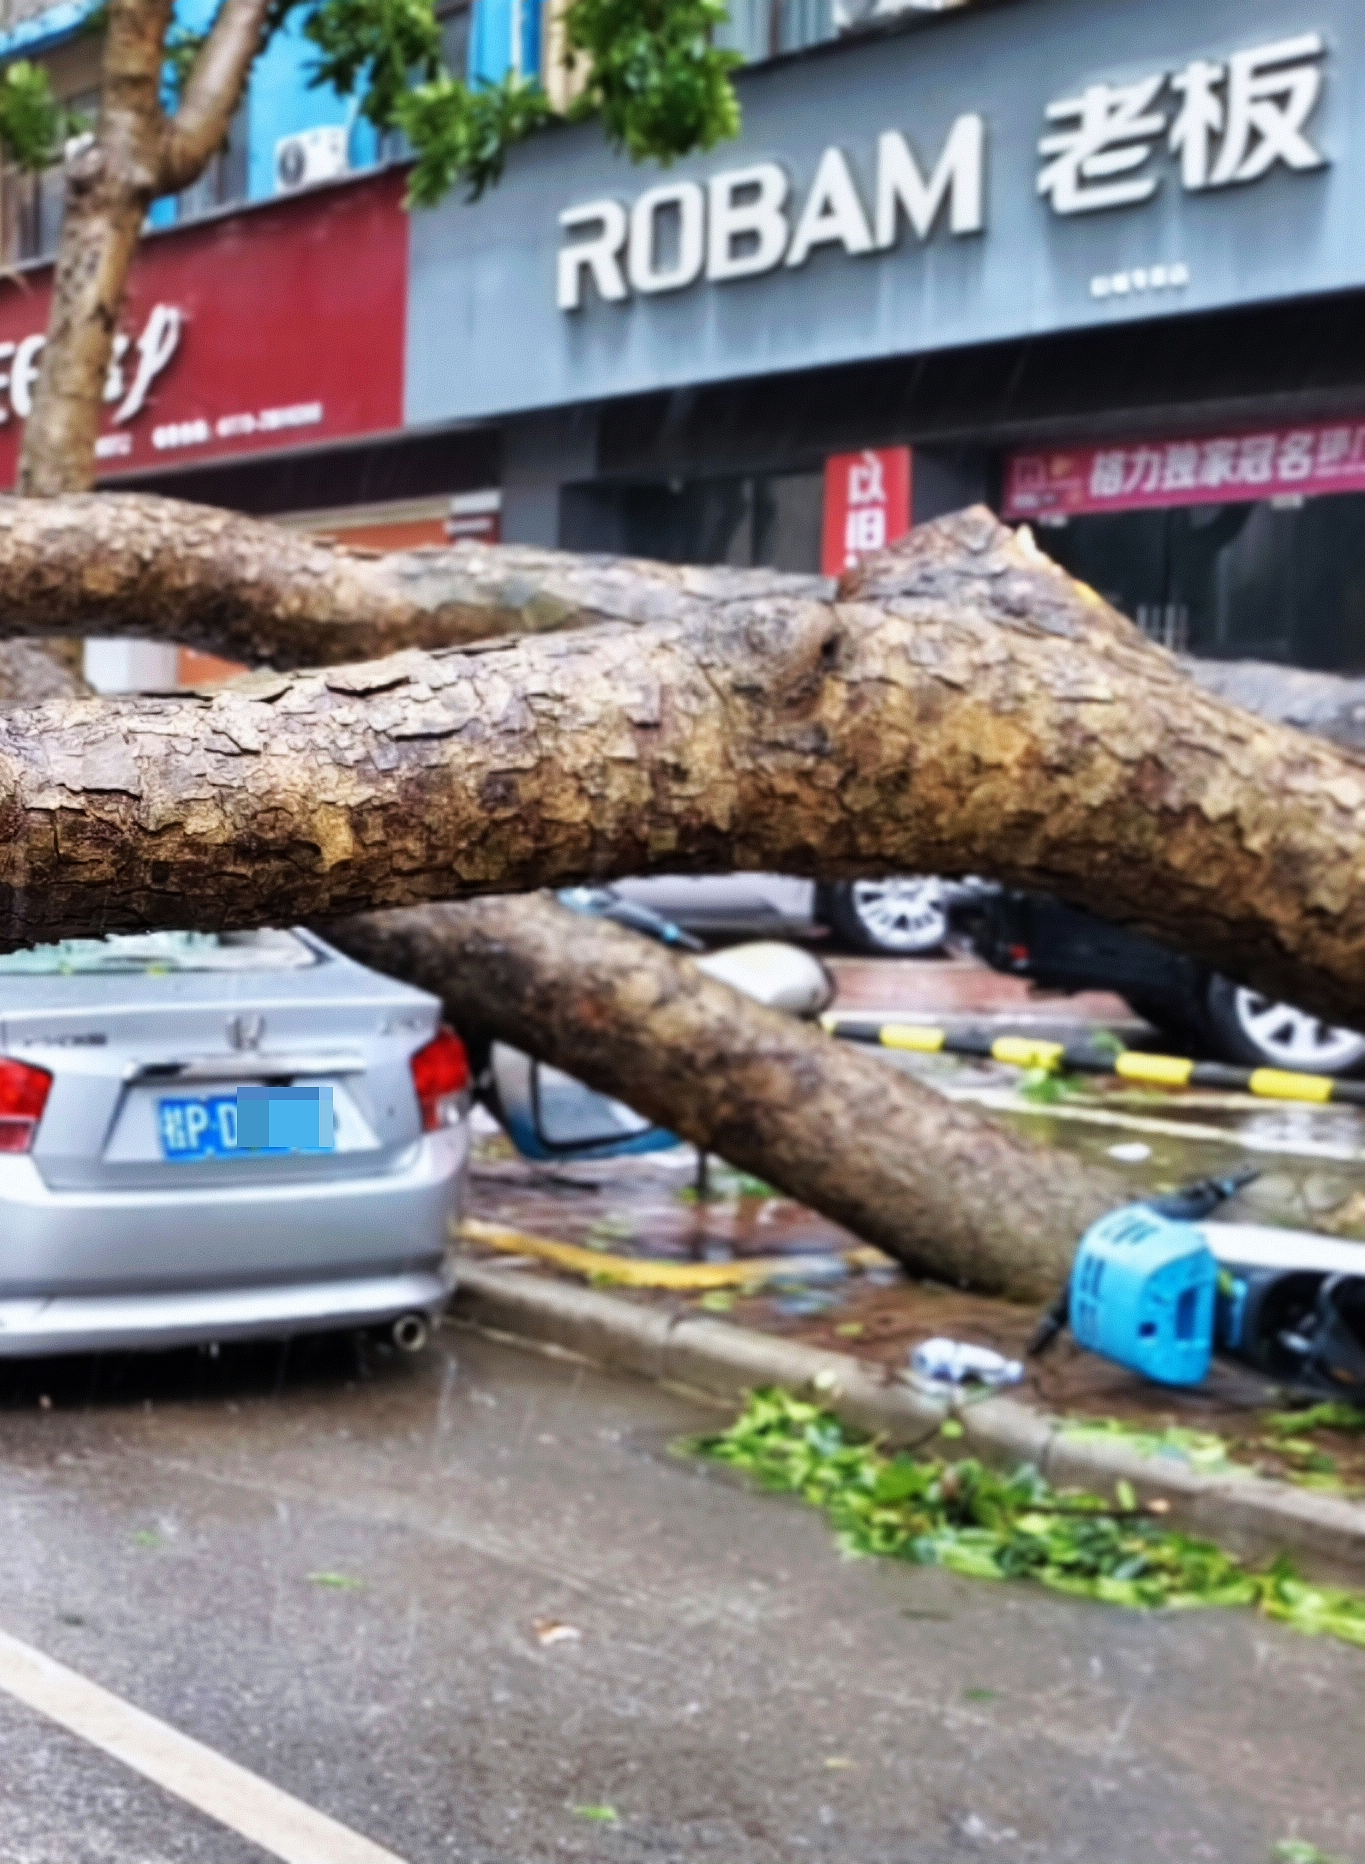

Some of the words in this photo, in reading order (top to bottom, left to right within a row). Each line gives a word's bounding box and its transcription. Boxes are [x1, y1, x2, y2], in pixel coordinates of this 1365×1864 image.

[557, 113, 985, 309] ROBAM
[1036, 32, 1324, 214] 老板
[844, 449, 888, 568] 以旧
